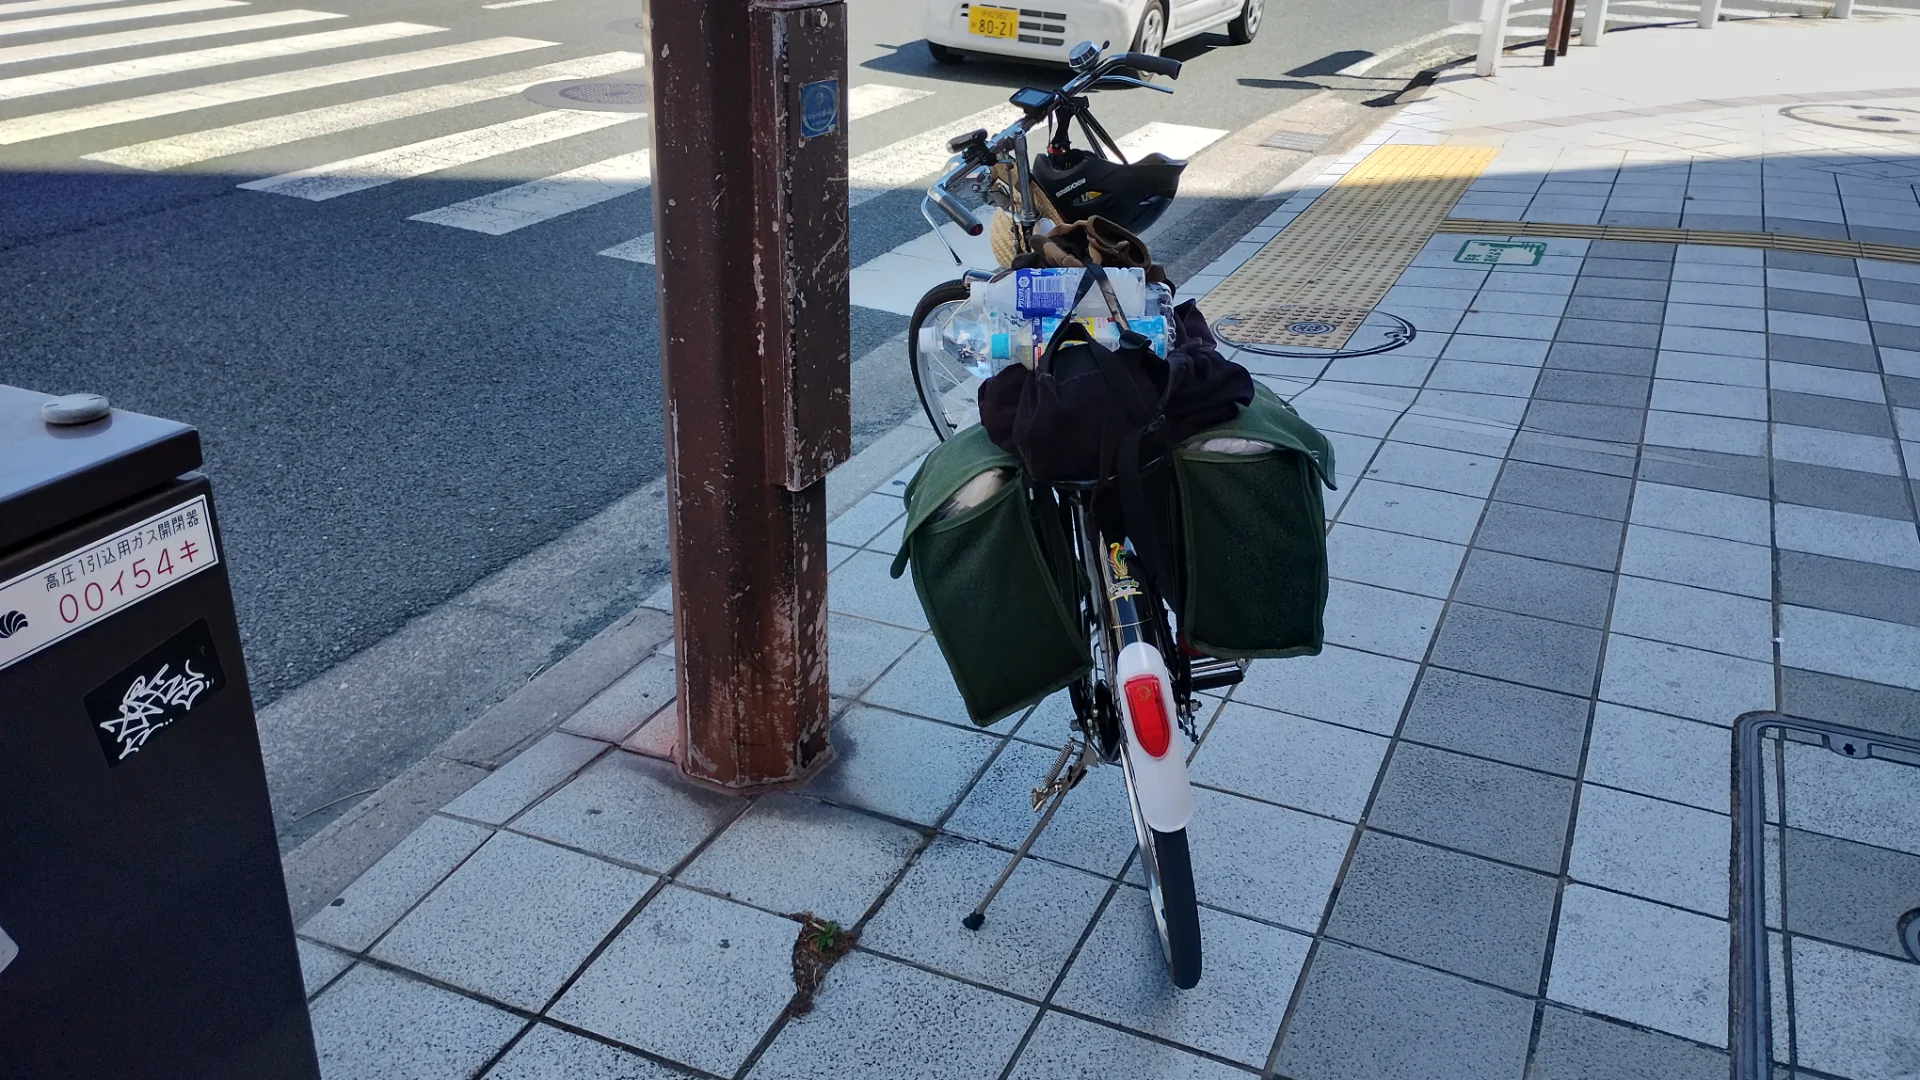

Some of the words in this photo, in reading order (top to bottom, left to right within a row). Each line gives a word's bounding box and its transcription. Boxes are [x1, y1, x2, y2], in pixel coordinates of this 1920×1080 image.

[979, 19, 1013, 37] 80-21
[44, 509, 199, 592] 高圧1引込用ガス開閉器
